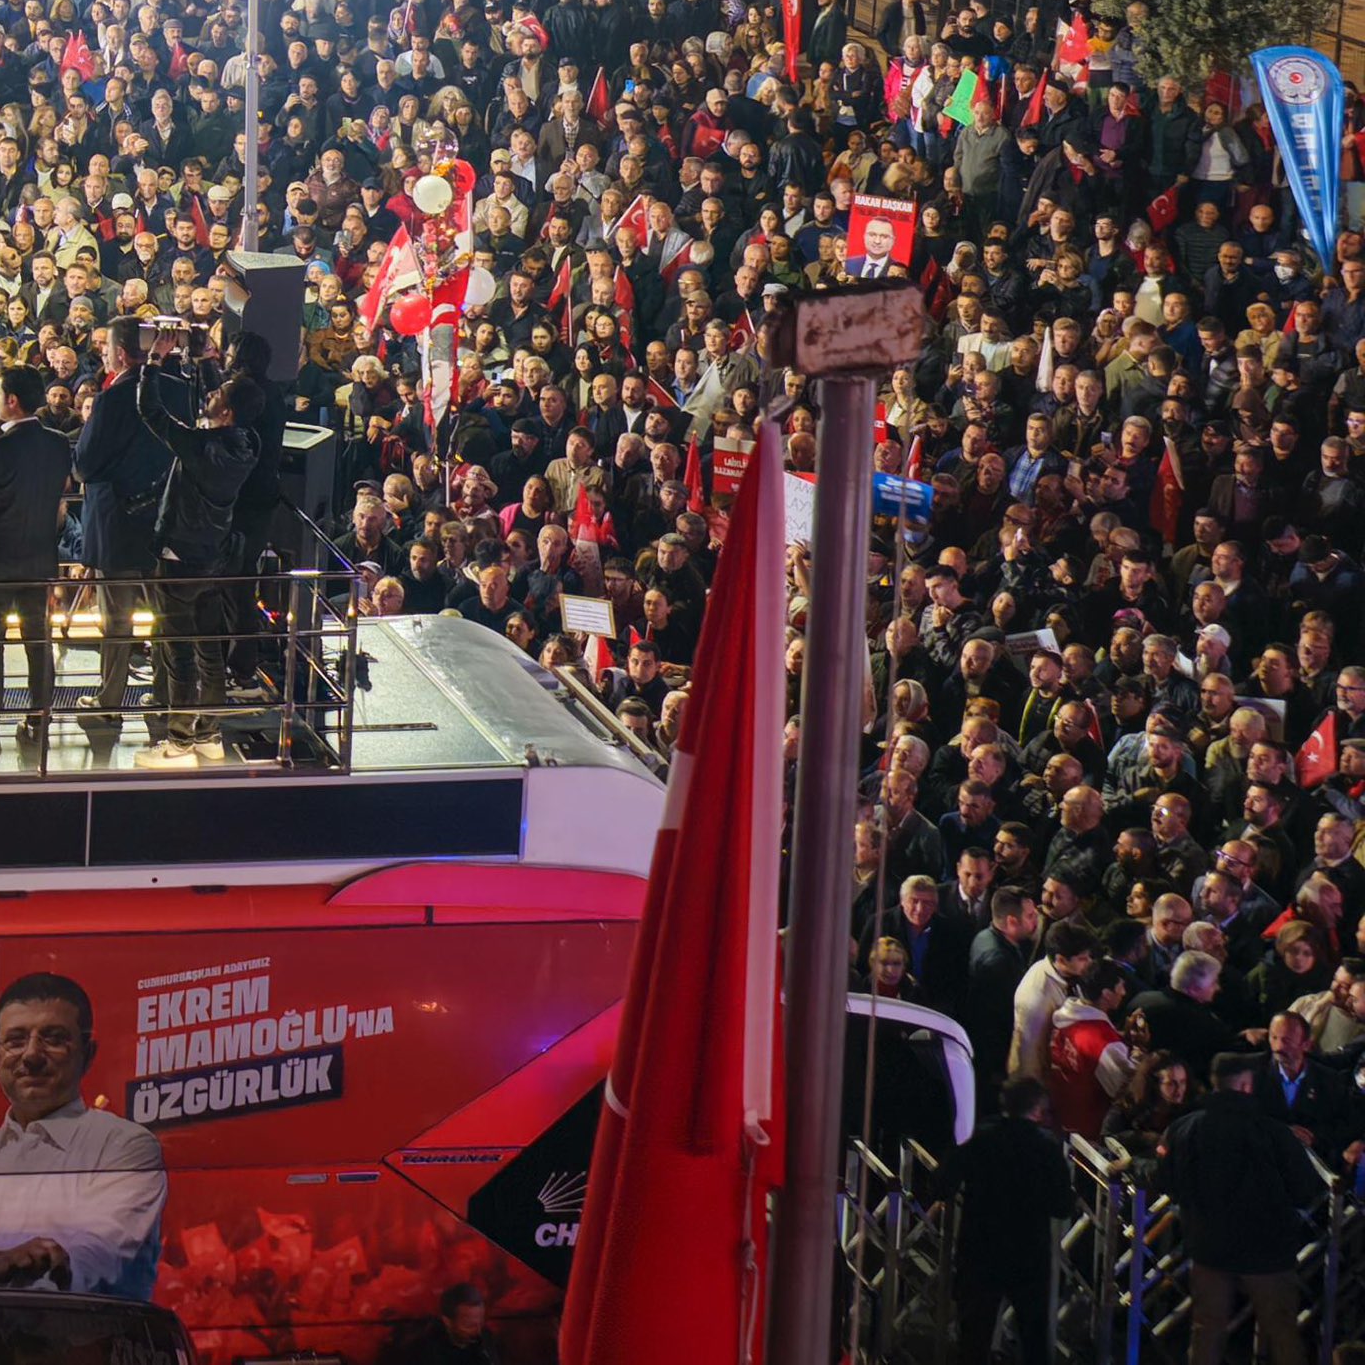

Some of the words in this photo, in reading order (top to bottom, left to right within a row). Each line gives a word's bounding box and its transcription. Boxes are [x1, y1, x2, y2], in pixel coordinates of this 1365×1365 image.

[855, 195, 882, 208] HAKAN
[883, 197, 913, 214] BAŞKAN
[137, 964, 221, 991] CUMHURBAŞKANI
[222, 956, 271, 975] ADAYIMIZ
[137, 976, 270, 1034] EKREM
[135, 1006, 394, 1078] İMAMOĞLU'NA
[132, 1054, 333, 1124] ÖZGÜRLÜK
[535, 1223, 580, 1248] CH
